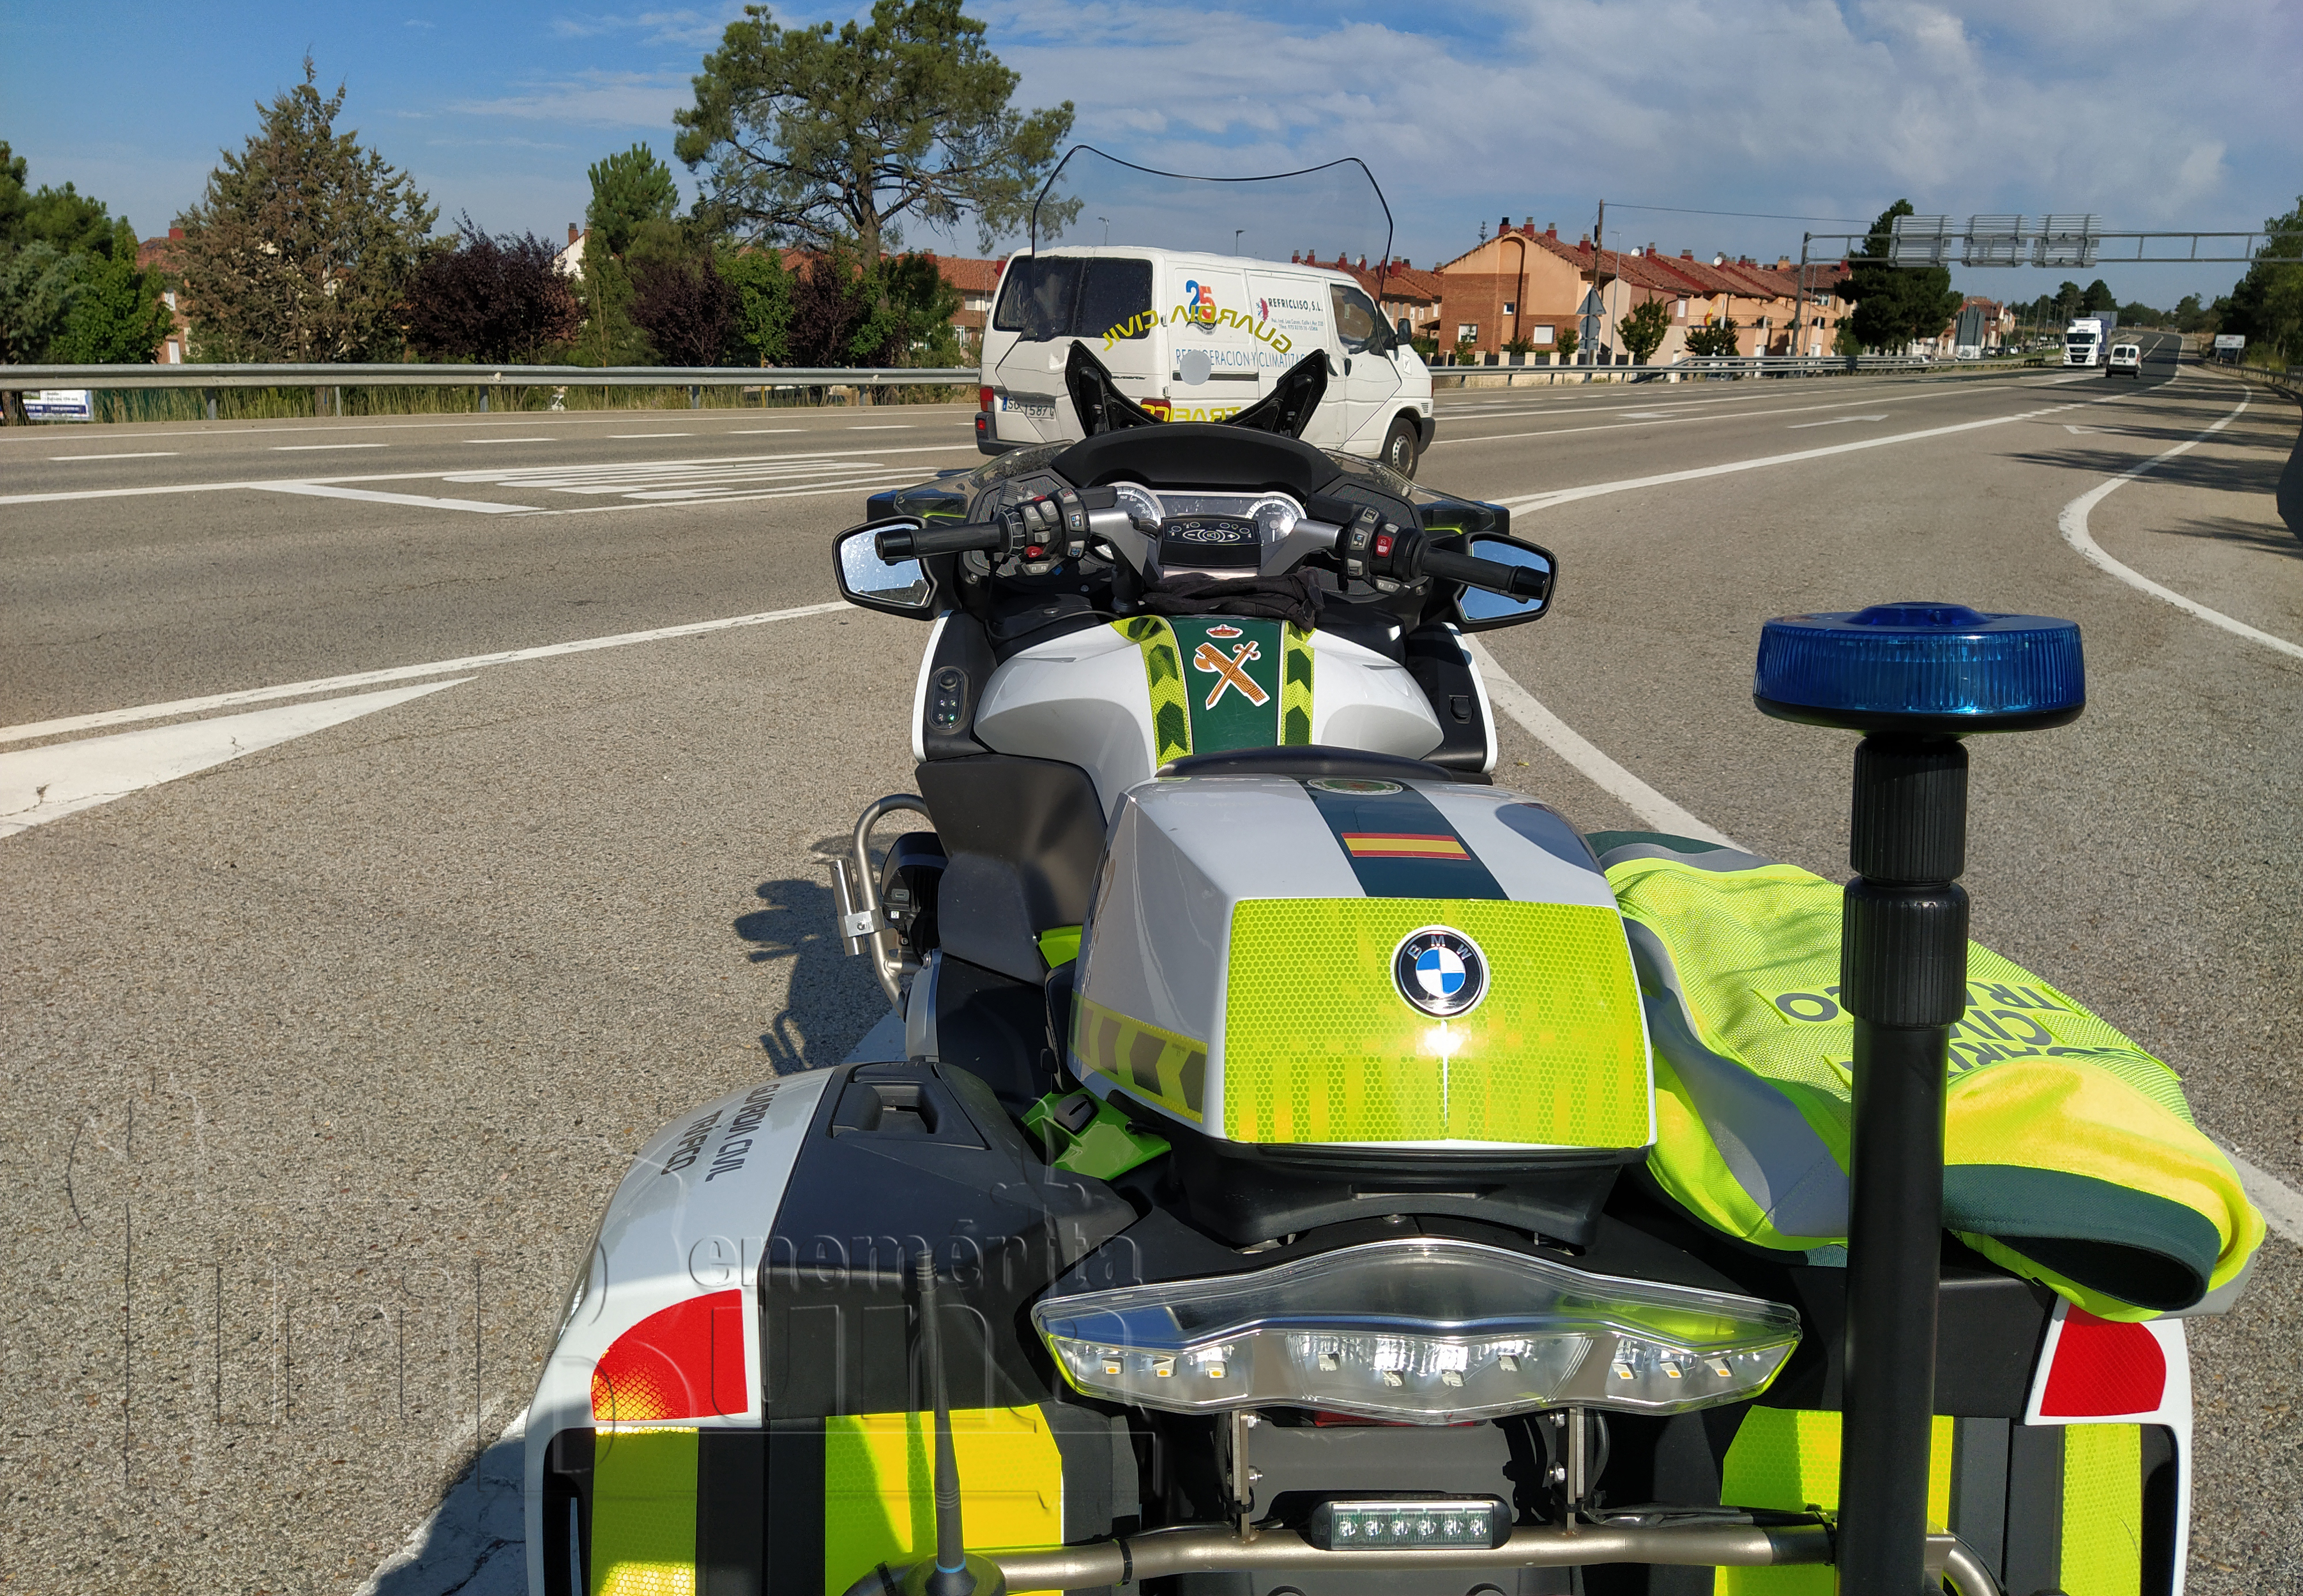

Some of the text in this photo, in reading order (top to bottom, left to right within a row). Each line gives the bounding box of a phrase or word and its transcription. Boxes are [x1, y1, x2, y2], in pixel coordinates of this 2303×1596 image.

[1185, 280, 1216, 320] 25
[1407, 935, 1473, 960] BMW
[660, 1109, 724, 1175] TRÁFICO
[705, 1083, 781, 1183] GUARDIA CIVIL
